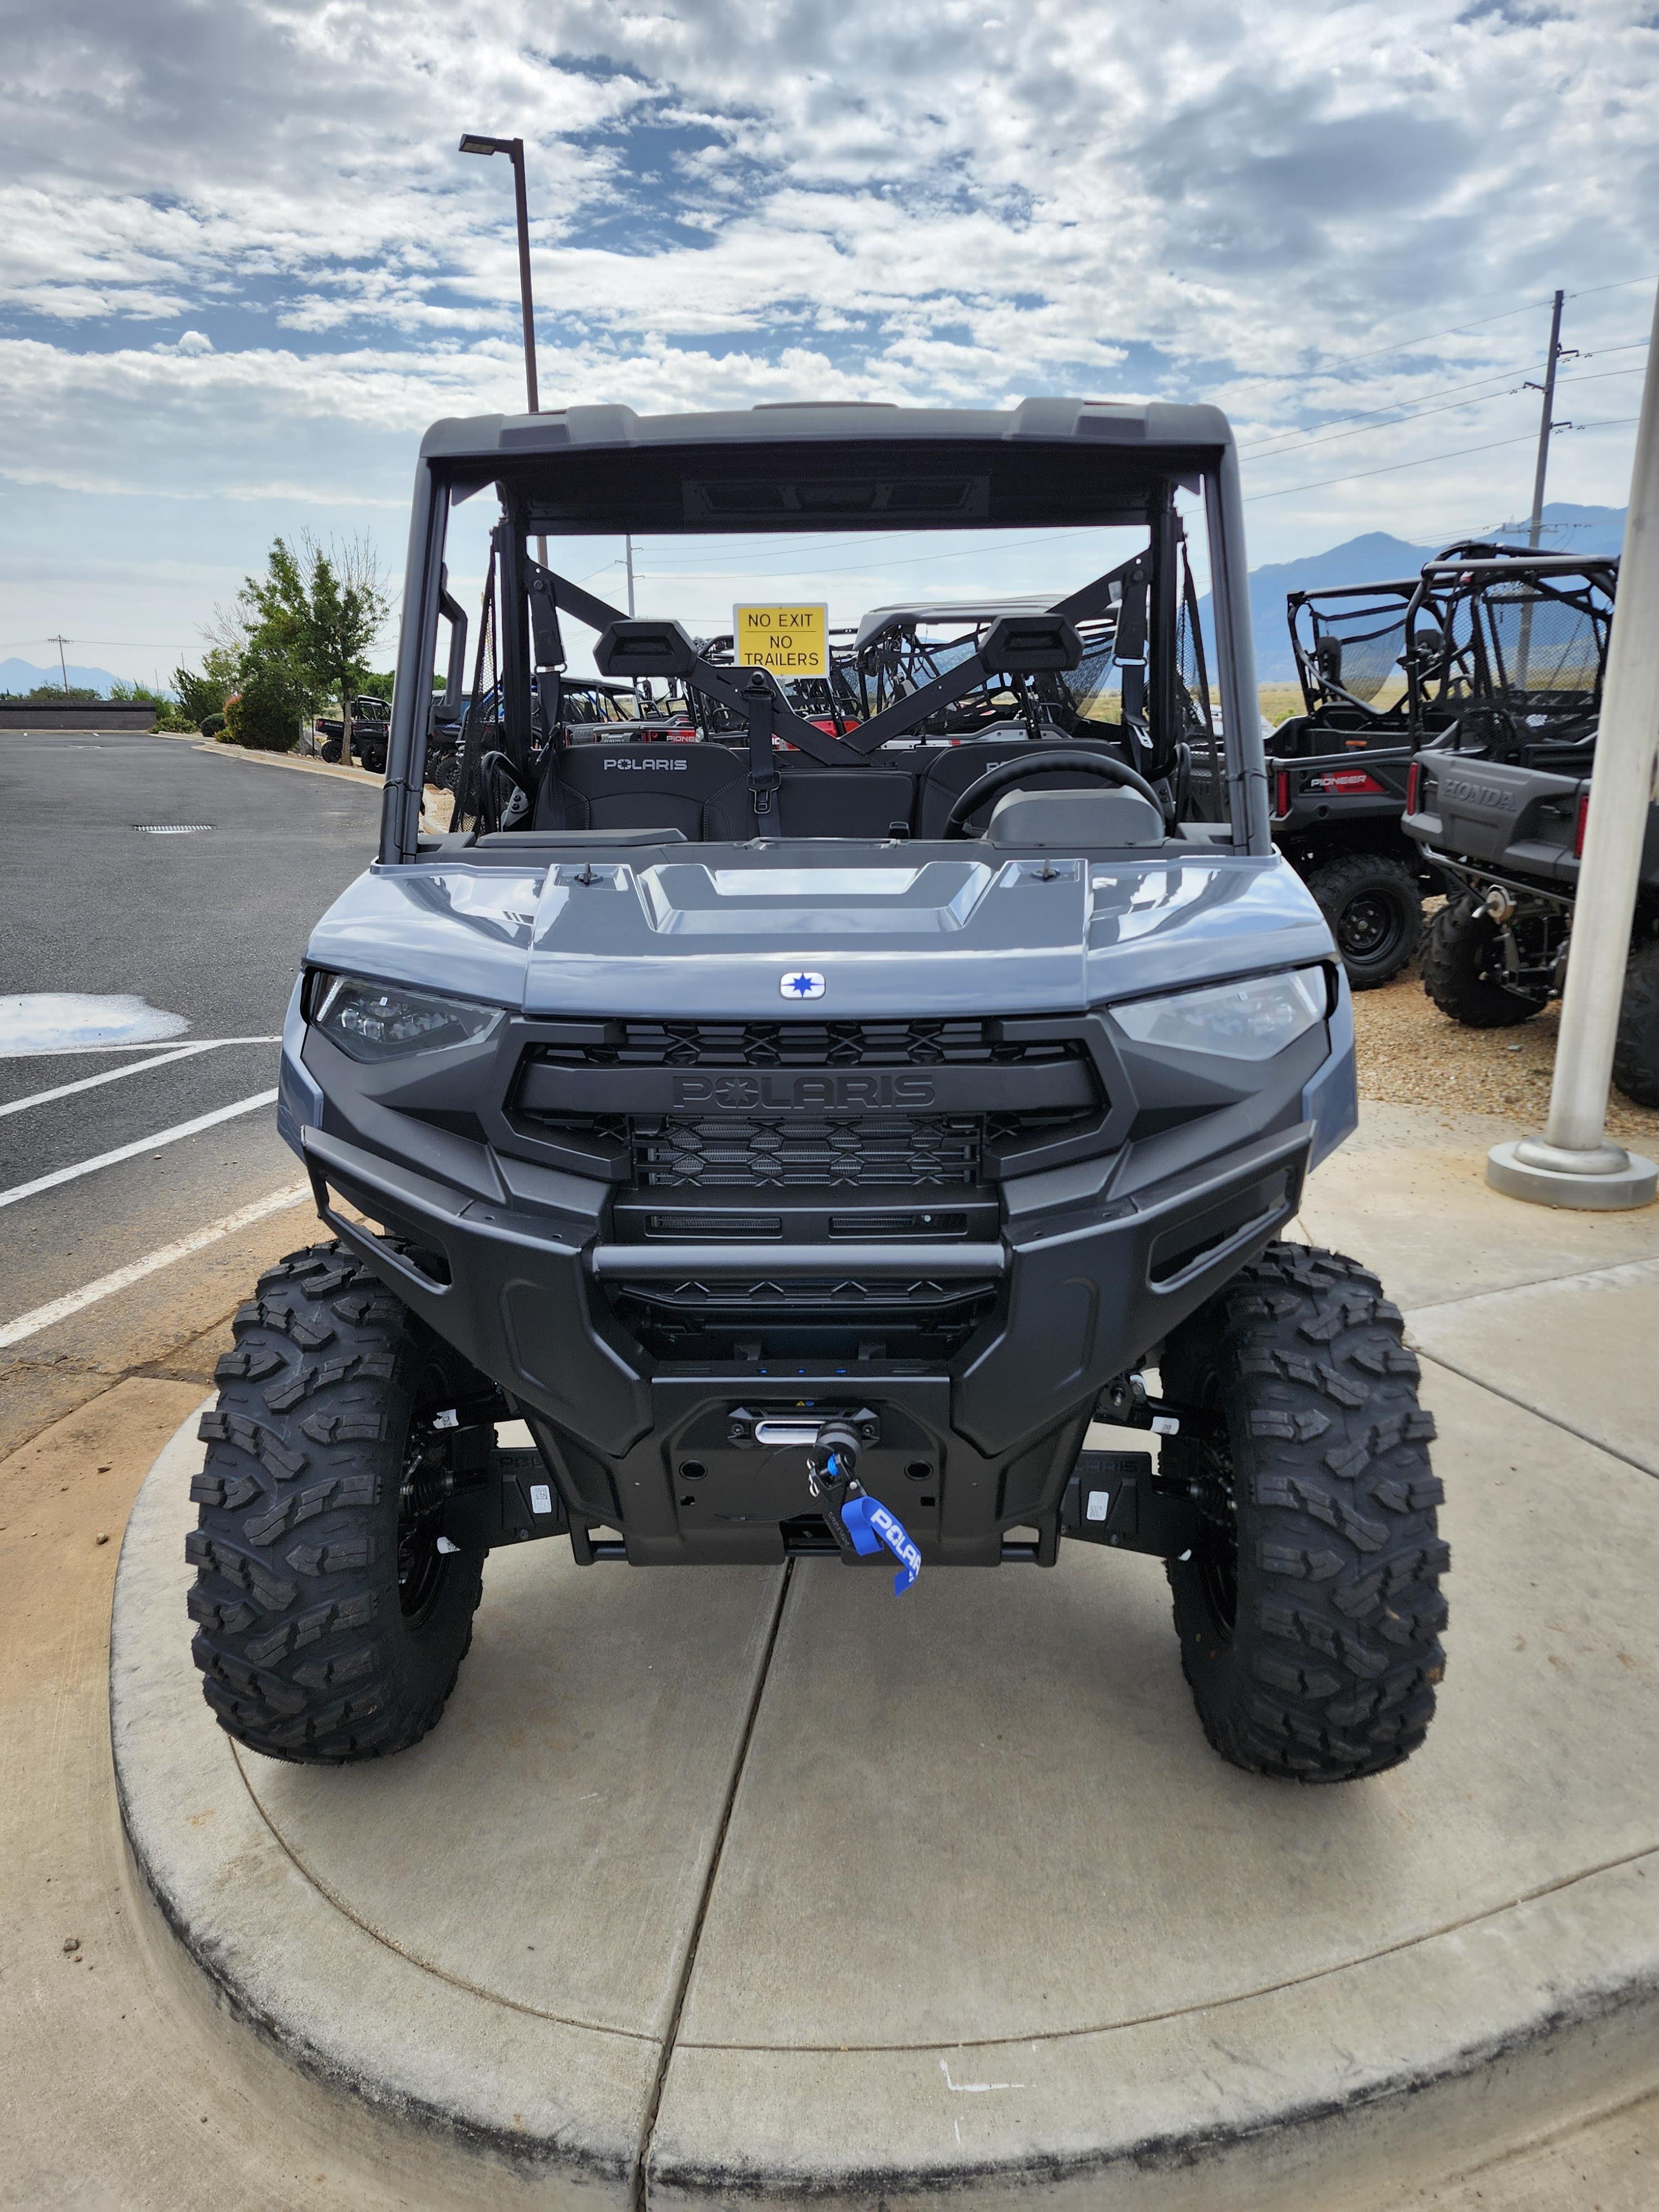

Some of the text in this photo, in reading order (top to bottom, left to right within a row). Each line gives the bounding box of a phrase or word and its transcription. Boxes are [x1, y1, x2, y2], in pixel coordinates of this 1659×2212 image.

[749, 614, 813, 627] NO EXIT
[770, 636, 792, 648] NO
[744, 653, 818, 666] TRAILERS
[603, 759, 688, 771] POLARIS
[1310, 775, 1367, 787] PIONEER
[1440, 779, 1516, 812] HONDA
[672, 1075, 936, 1109] POLARIS
[870, 1508, 922, 1583] POLAR
